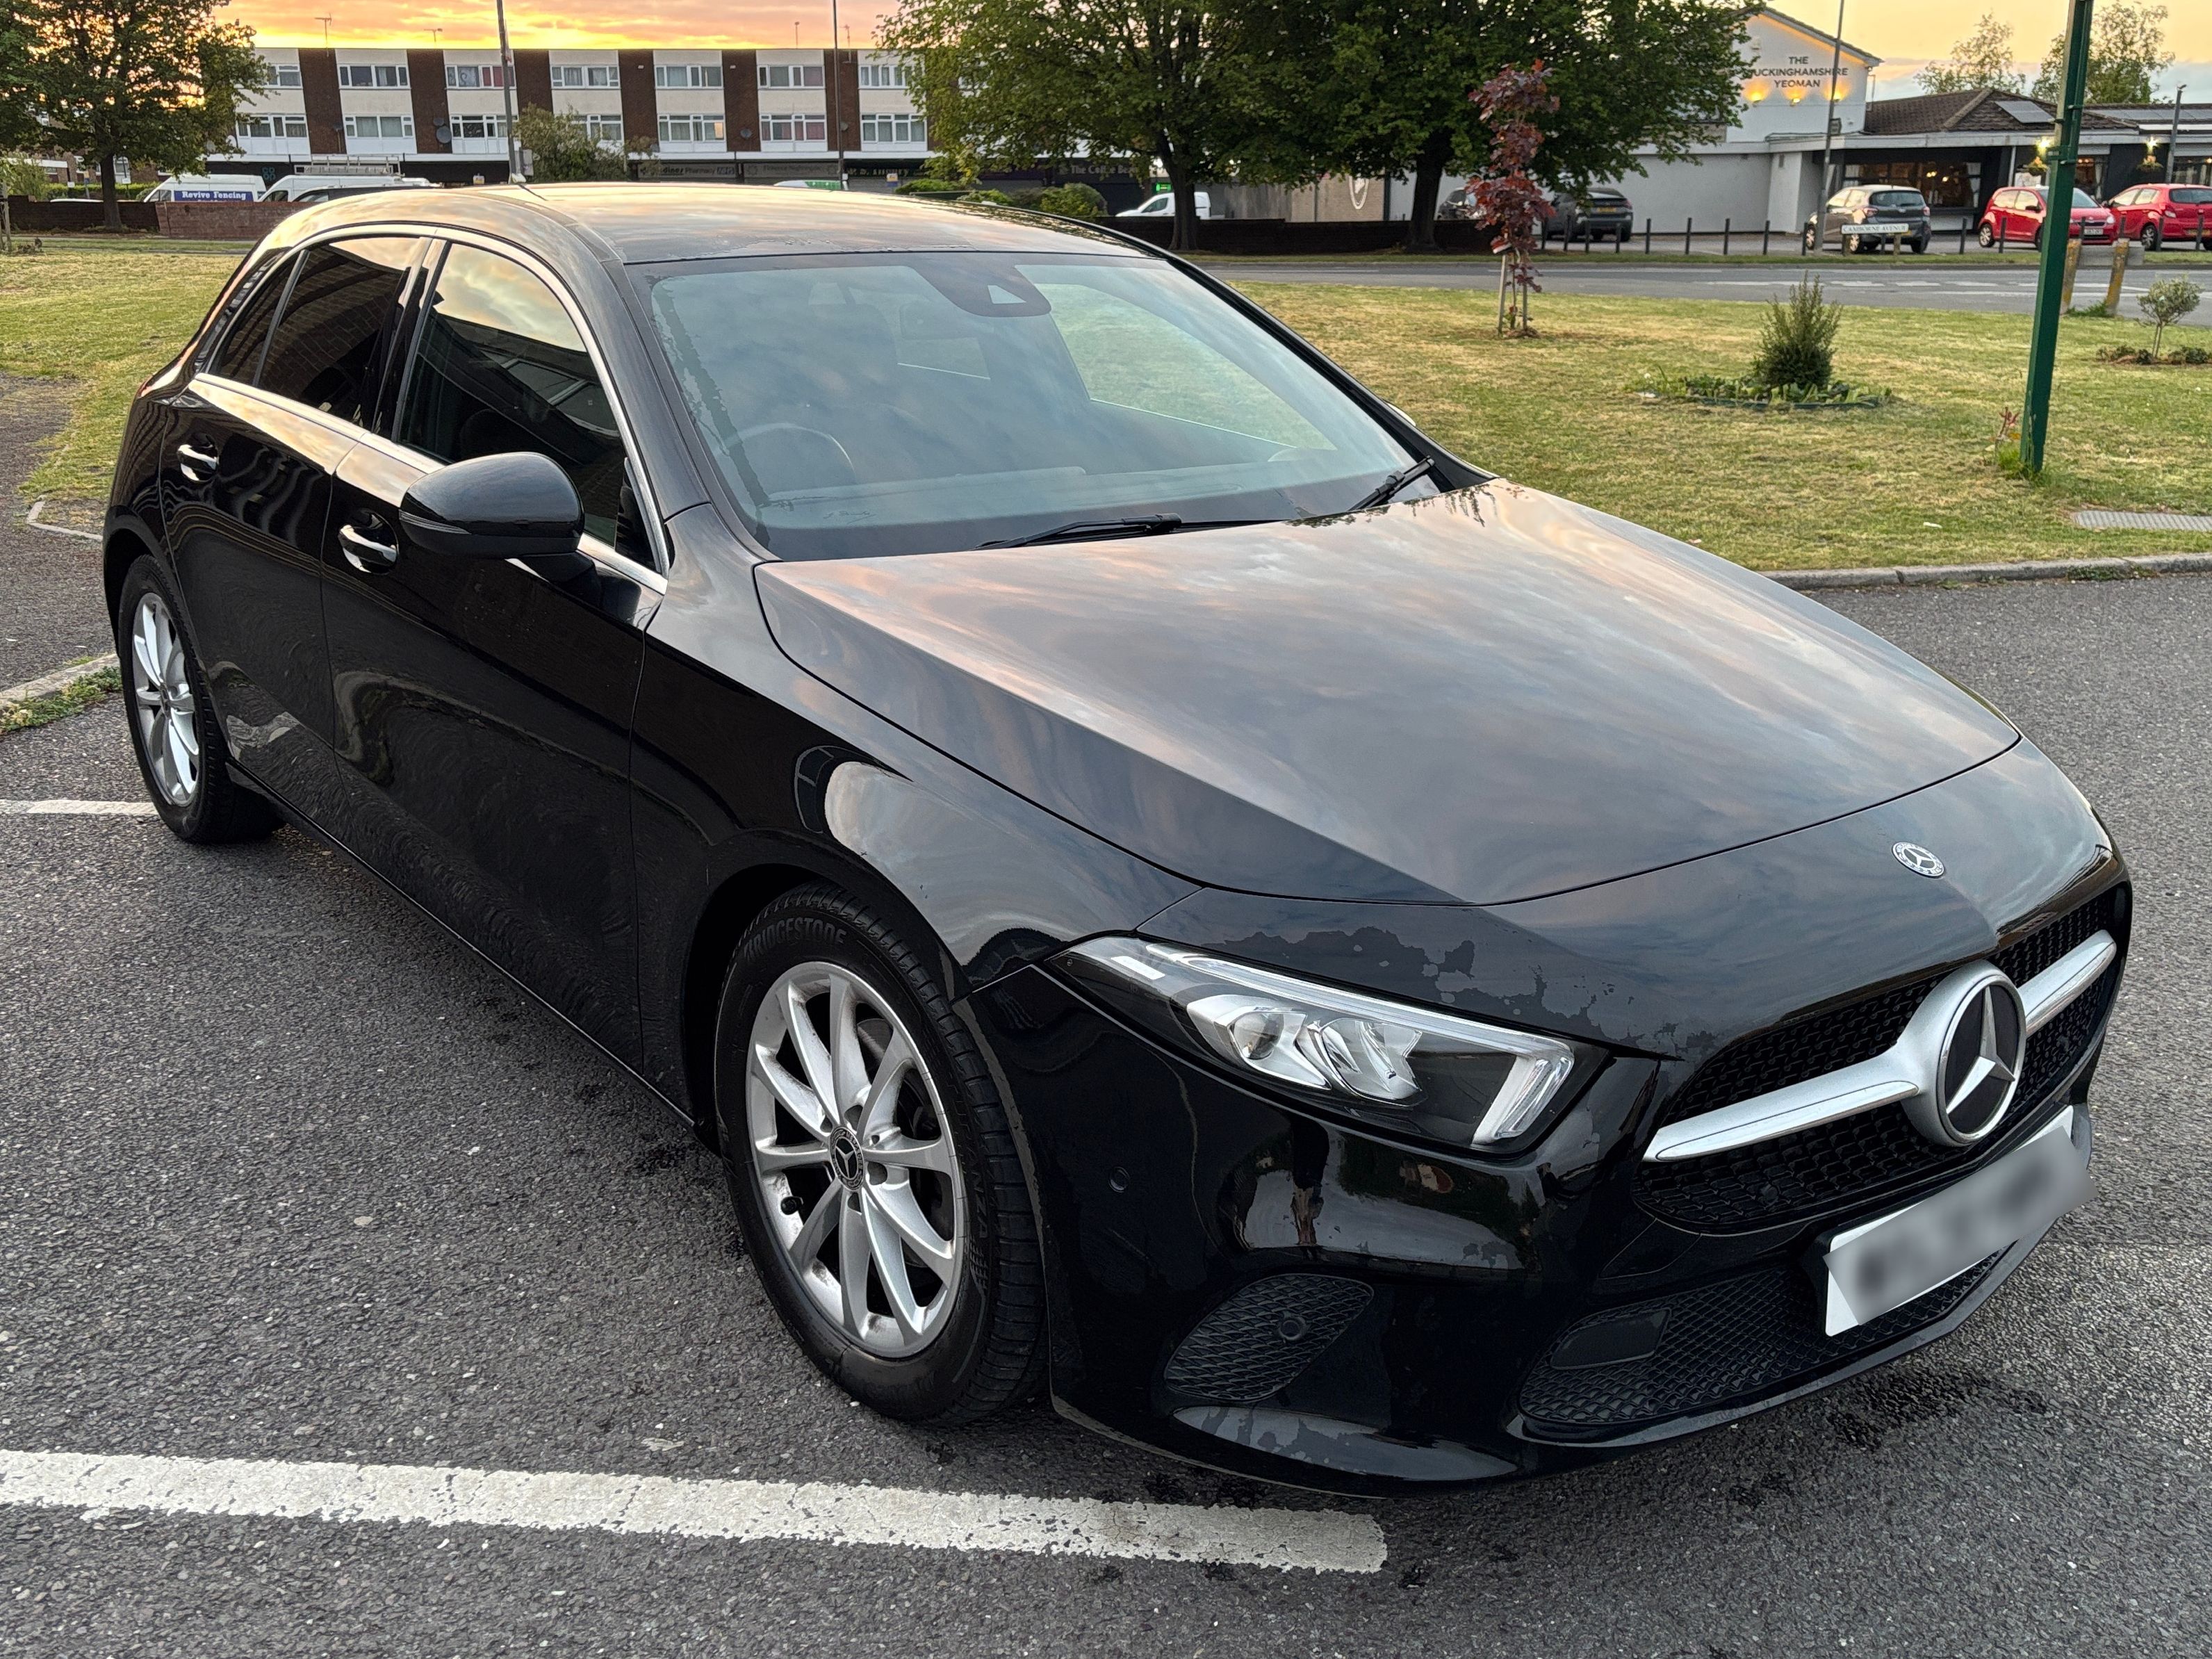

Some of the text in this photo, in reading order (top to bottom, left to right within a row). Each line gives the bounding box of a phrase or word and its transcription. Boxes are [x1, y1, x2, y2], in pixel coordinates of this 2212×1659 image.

[1789, 56, 1809, 65] THE
[1748, 67, 1849, 76] UCKINGHAMSHRE
[1773, 79, 1821, 88] YEOMAN
[1071, 165, 1086, 174] The
[1088, 165, 1116, 174] Coffe
[213, 191, 247, 201] Fencing
